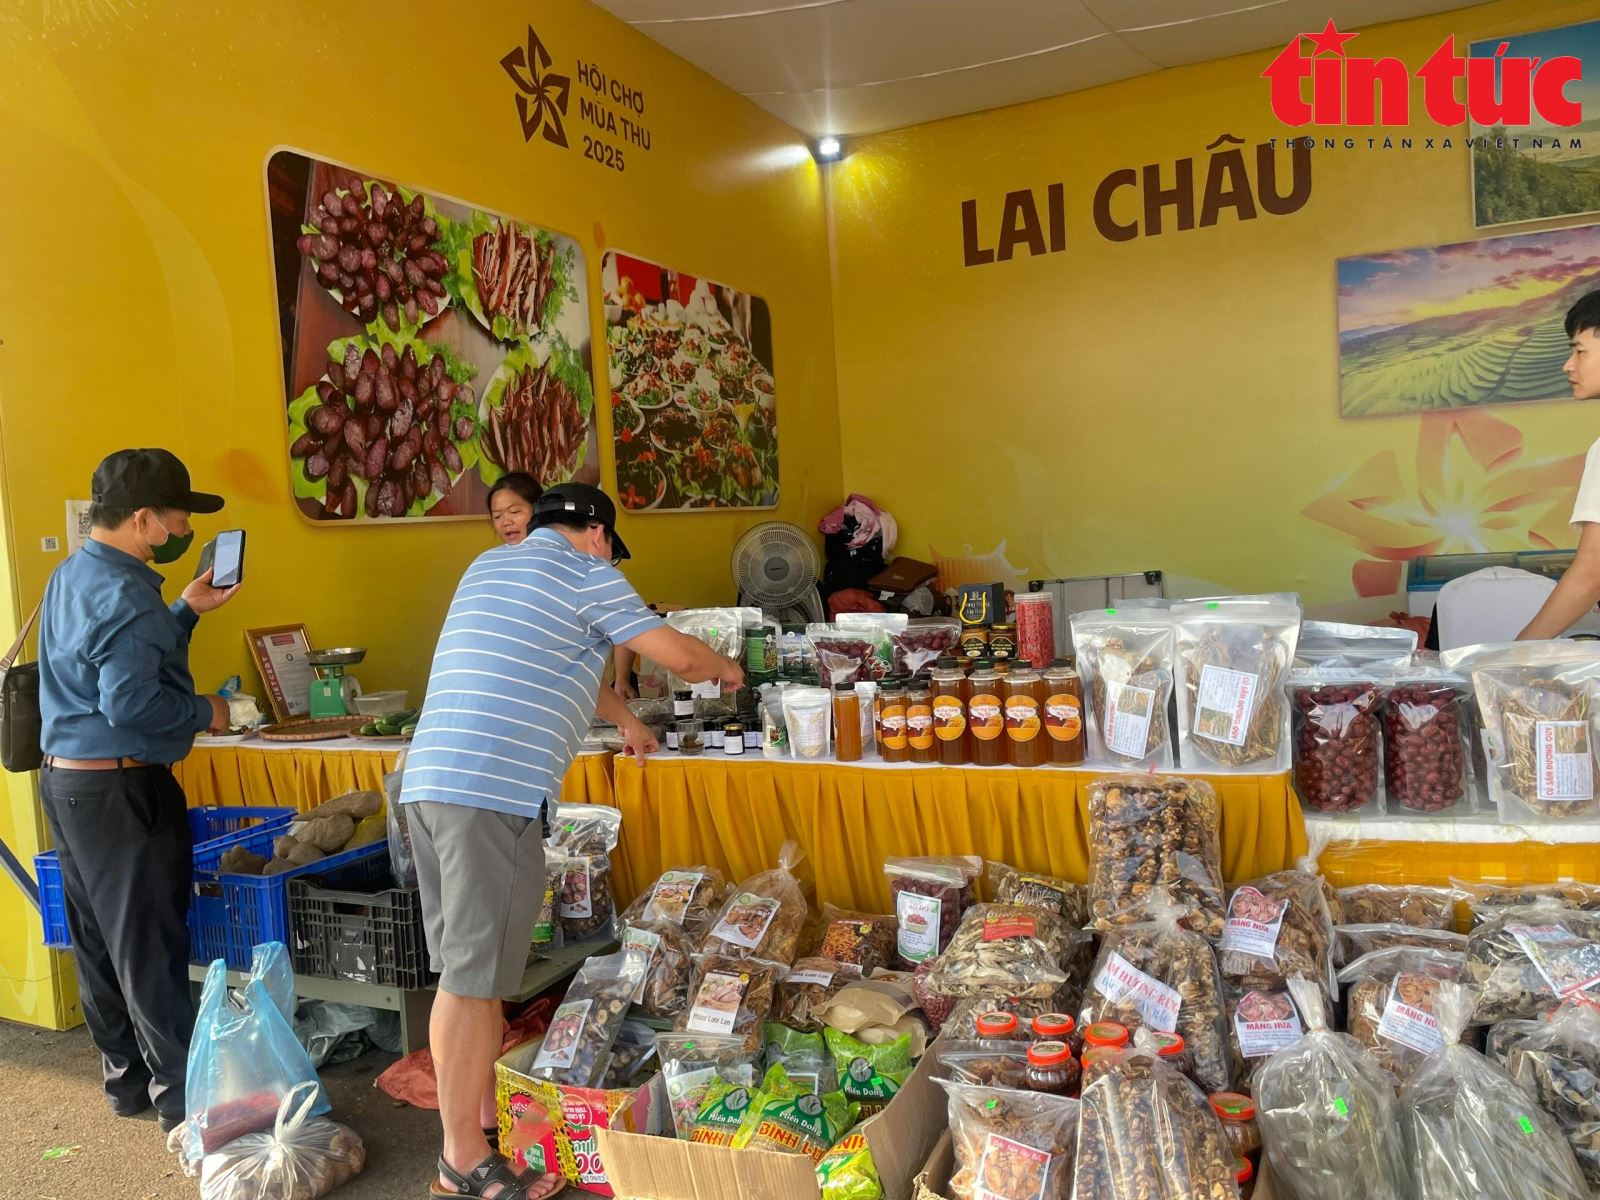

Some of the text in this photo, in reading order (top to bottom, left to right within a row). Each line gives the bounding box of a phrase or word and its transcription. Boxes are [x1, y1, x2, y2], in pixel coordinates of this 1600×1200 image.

[577, 59, 644, 118] HỘI CHỢ
[580, 97, 651, 150] MÙA THU
[583, 134, 625, 172] 2025
[962, 134, 1312, 267] LAI CHÂU
[727, 1116, 743, 1125] Don
[757, 1121, 800, 1150] BÌNH
[779, 1110, 823, 1137] Miến Dong
